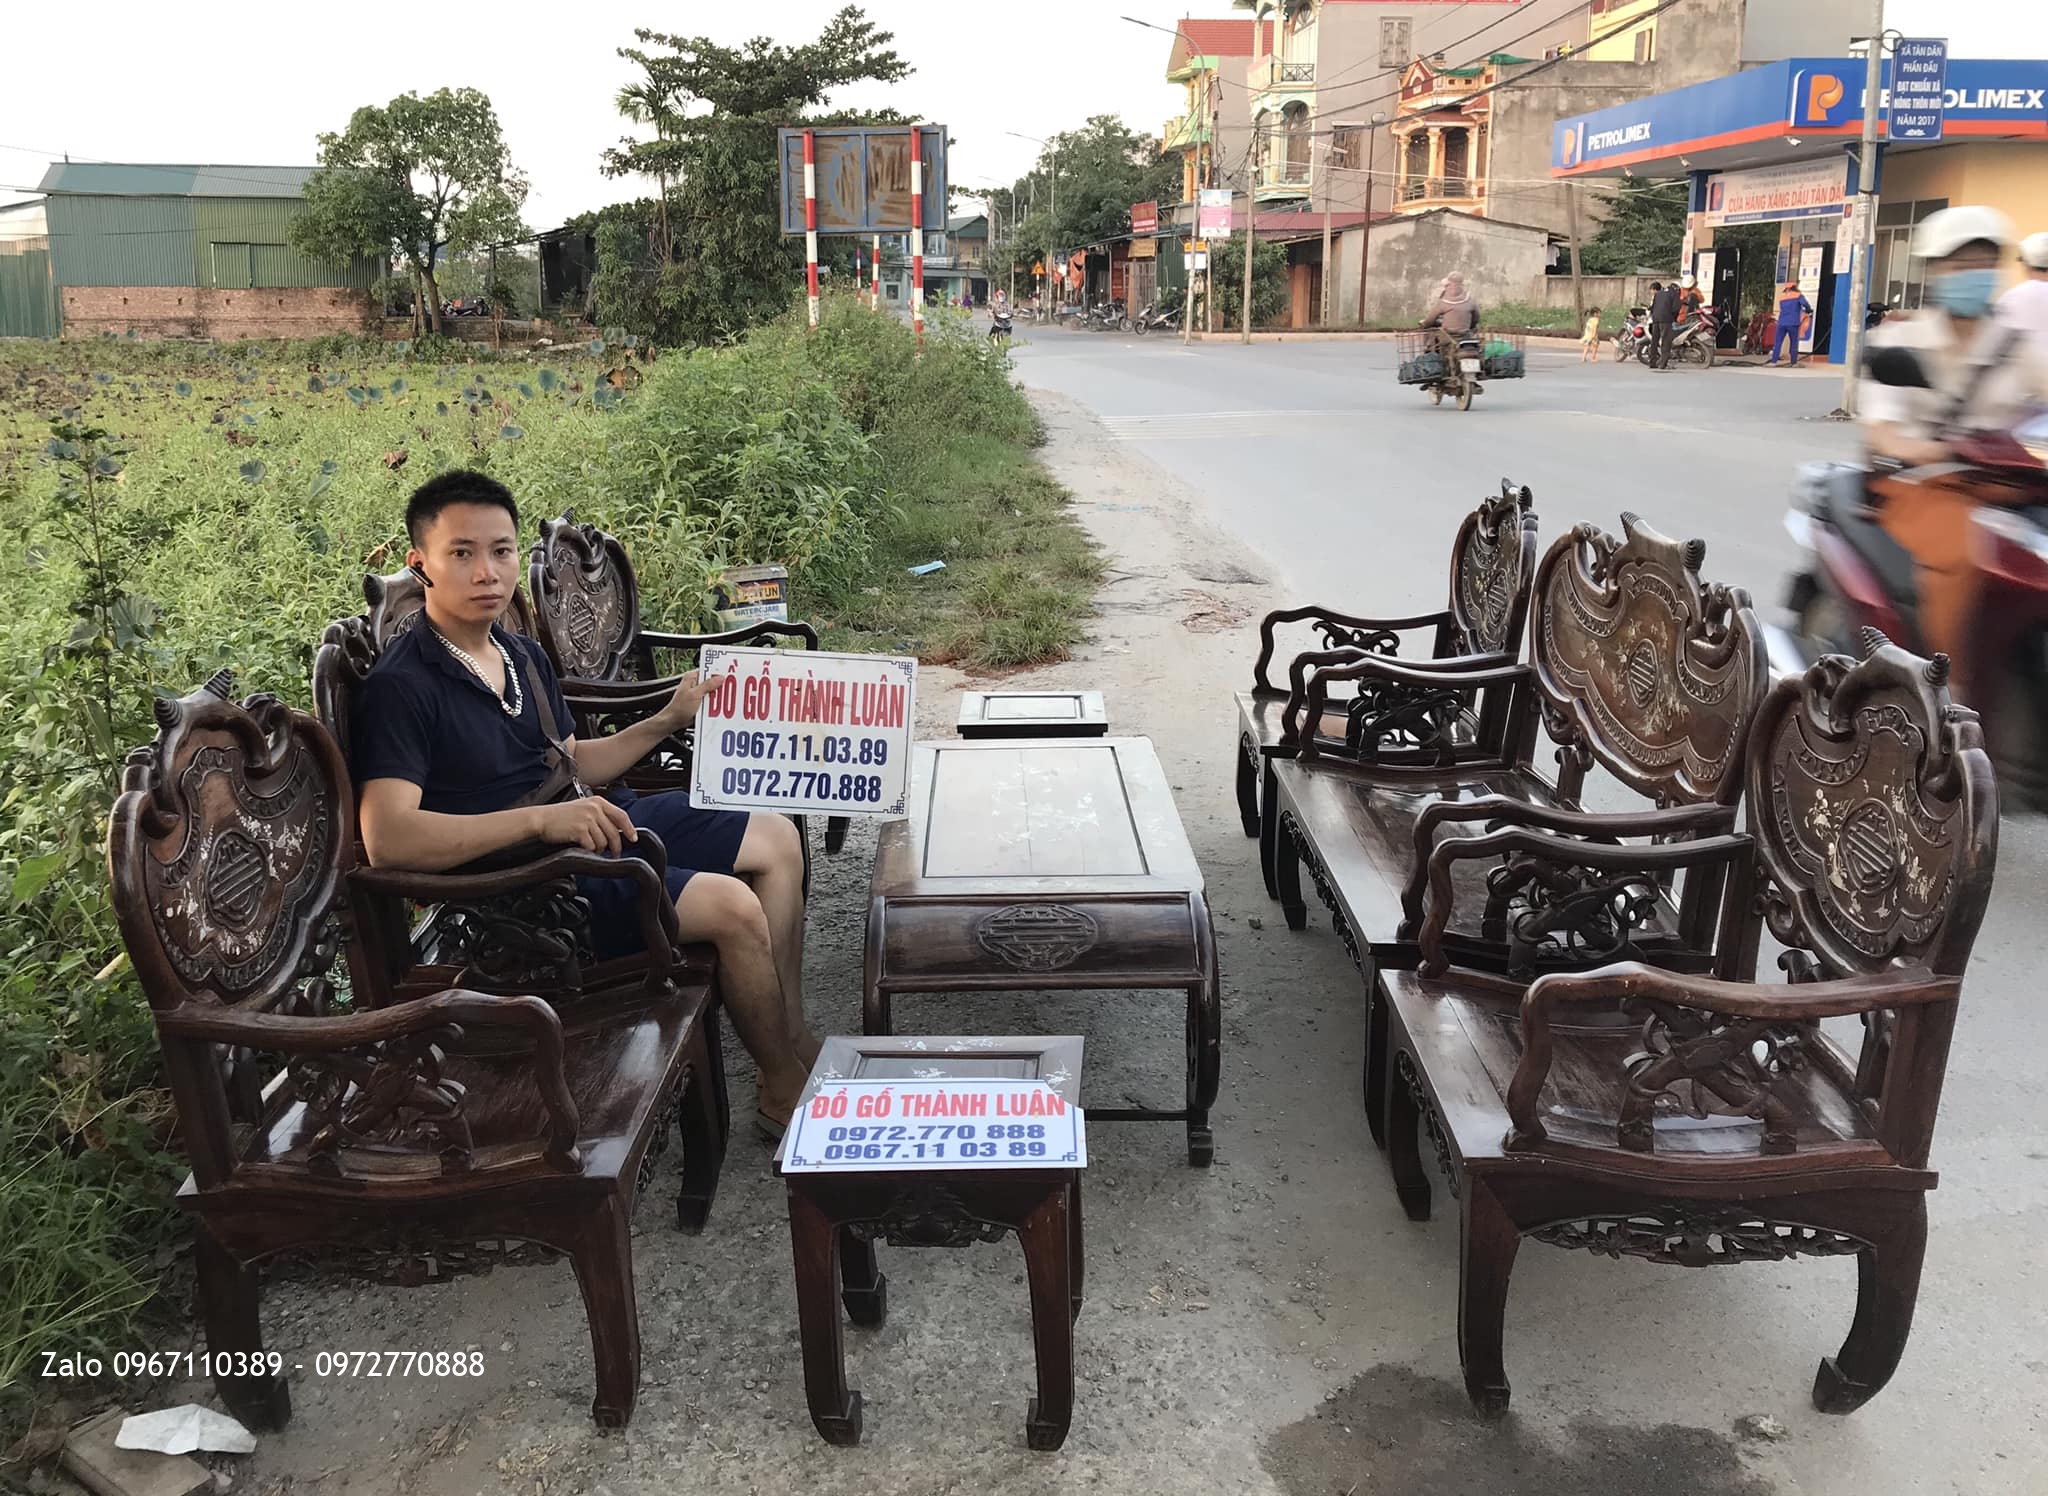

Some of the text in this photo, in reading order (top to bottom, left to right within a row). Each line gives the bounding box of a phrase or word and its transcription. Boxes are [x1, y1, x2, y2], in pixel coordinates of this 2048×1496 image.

[1912, 44, 1926, 56] TÂN
[1903, 60, 1922, 72] PHẤN
[1861, 89, 2044, 109] EOLIMEX
[1897, 114, 1936, 125] NĂM 2017
[1588, 122, 1651, 151] PETROLIMEX
[708, 659, 905, 729] ĐỒ GỖ THÀNH LUÂN
[721, 730, 888, 766] 0967.11.03.89
[722, 767, 882, 802] 0972.770.888
[811, 1087, 1065, 1119] ĐỒ GỖ THÀNH LUÂN
[828, 1124, 1045, 1141] 0972.770 888
[824, 1142, 1046, 1159] 0967.11 03 89
